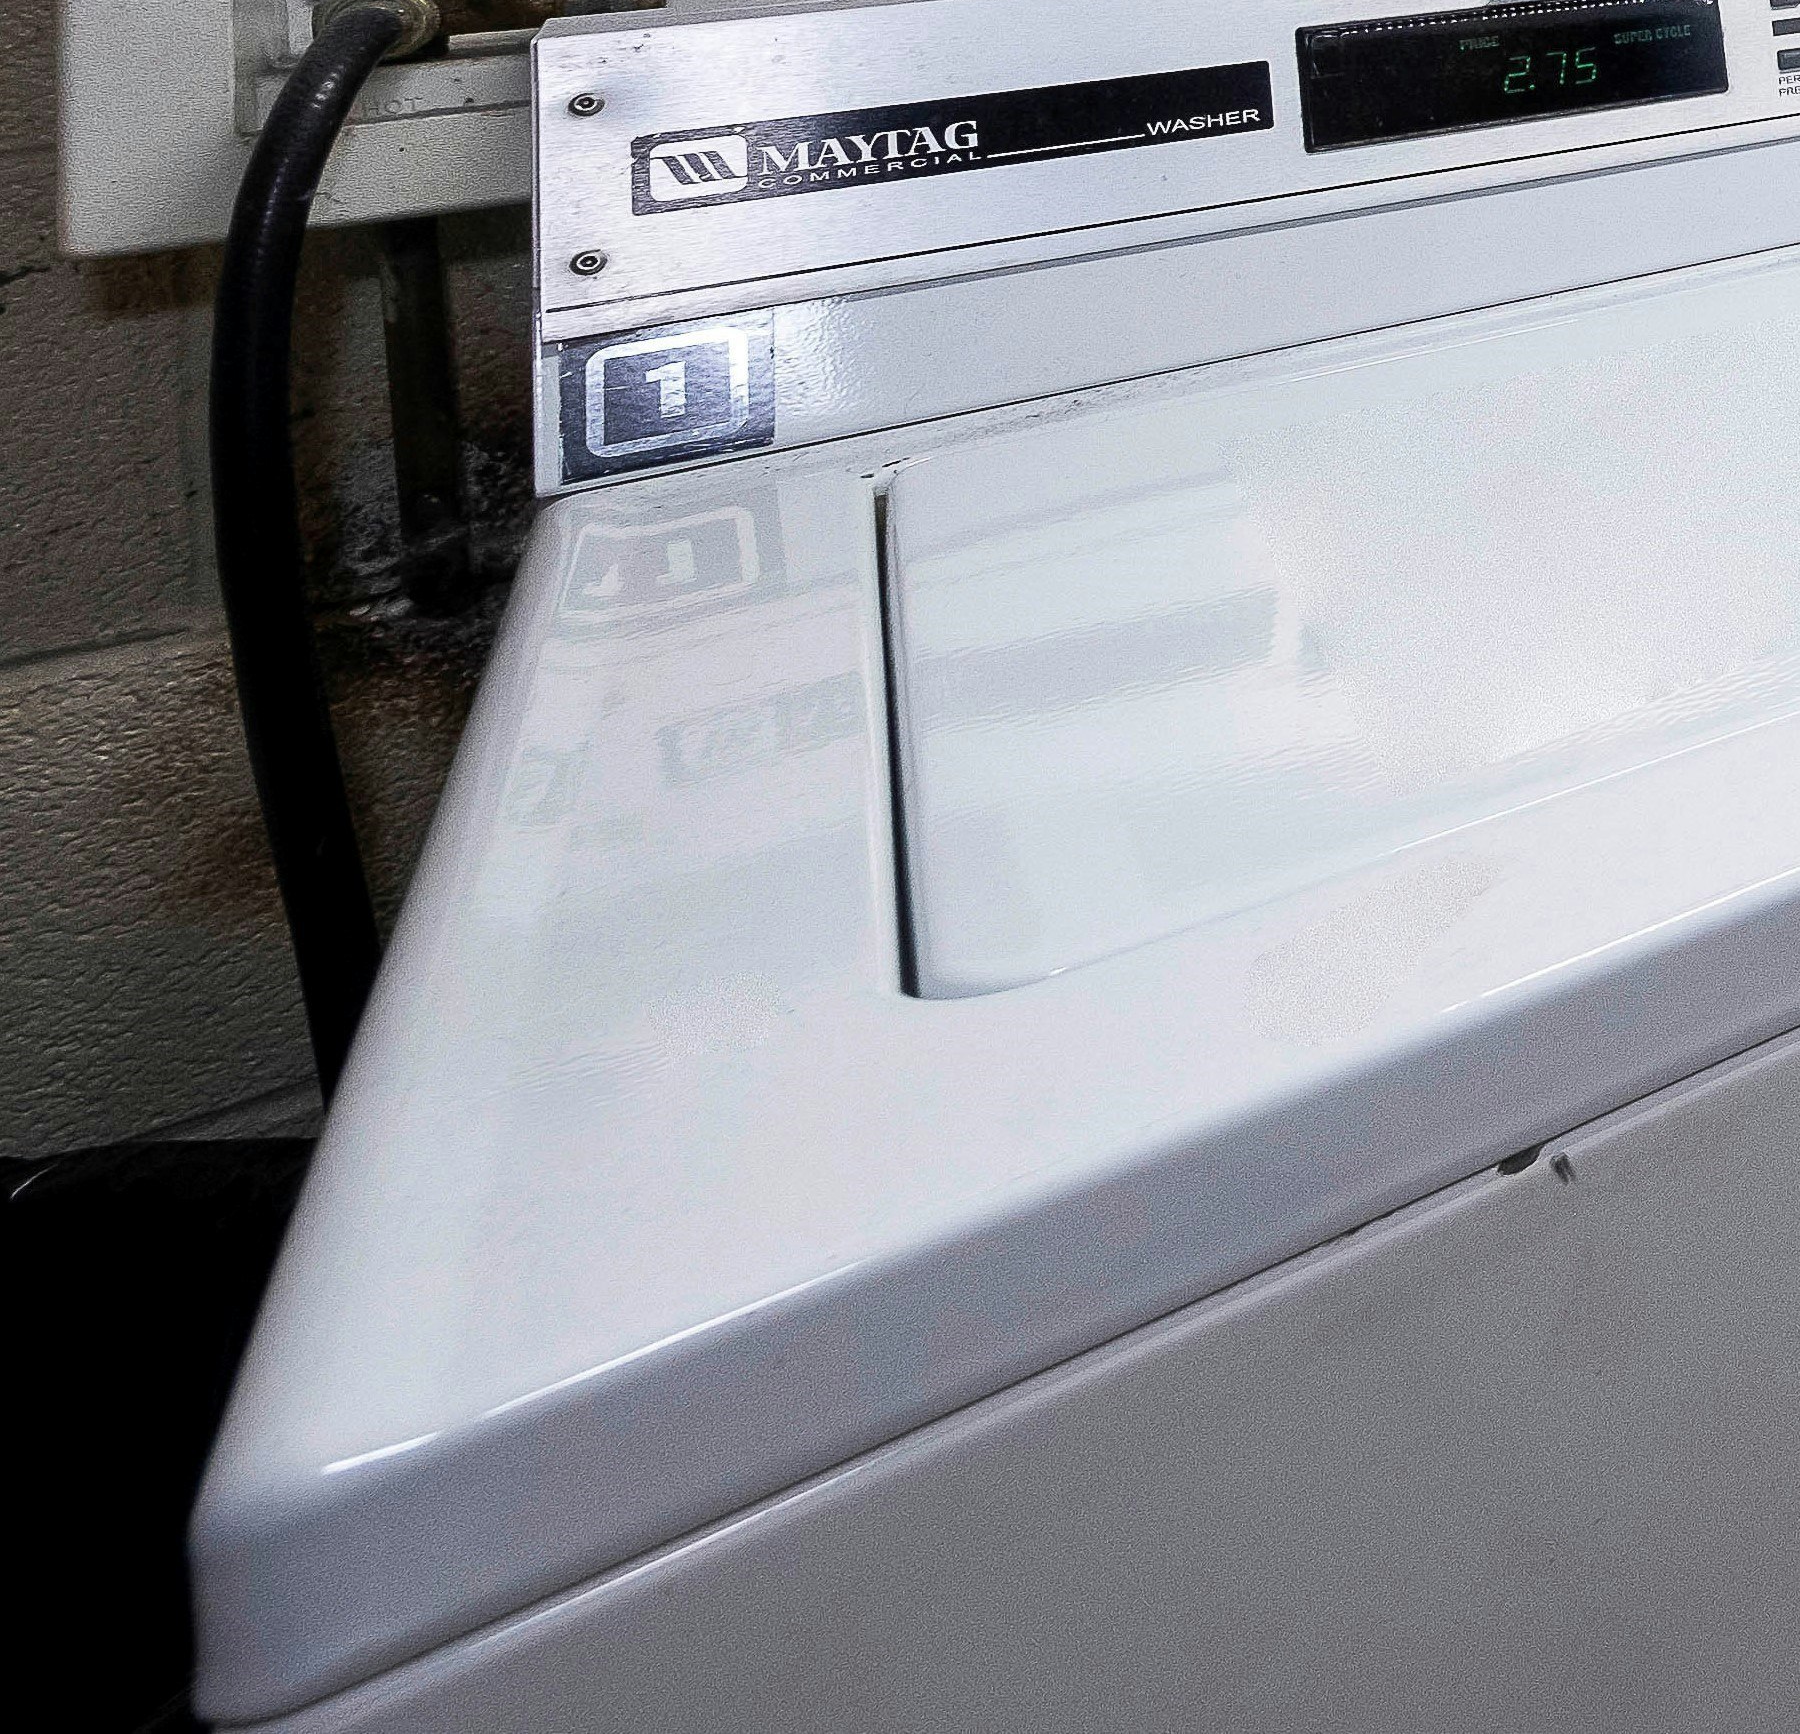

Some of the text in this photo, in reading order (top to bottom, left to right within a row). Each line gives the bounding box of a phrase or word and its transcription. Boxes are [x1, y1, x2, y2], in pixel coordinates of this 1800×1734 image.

[1504, 47, 1597, 94] 2.75
[1146, 108, 1261, 138] WASHER
[757, 120, 979, 176] MAYTAG
[757, 150, 983, 190] COMMERCIAL
[645, 359, 687, 419] 1
